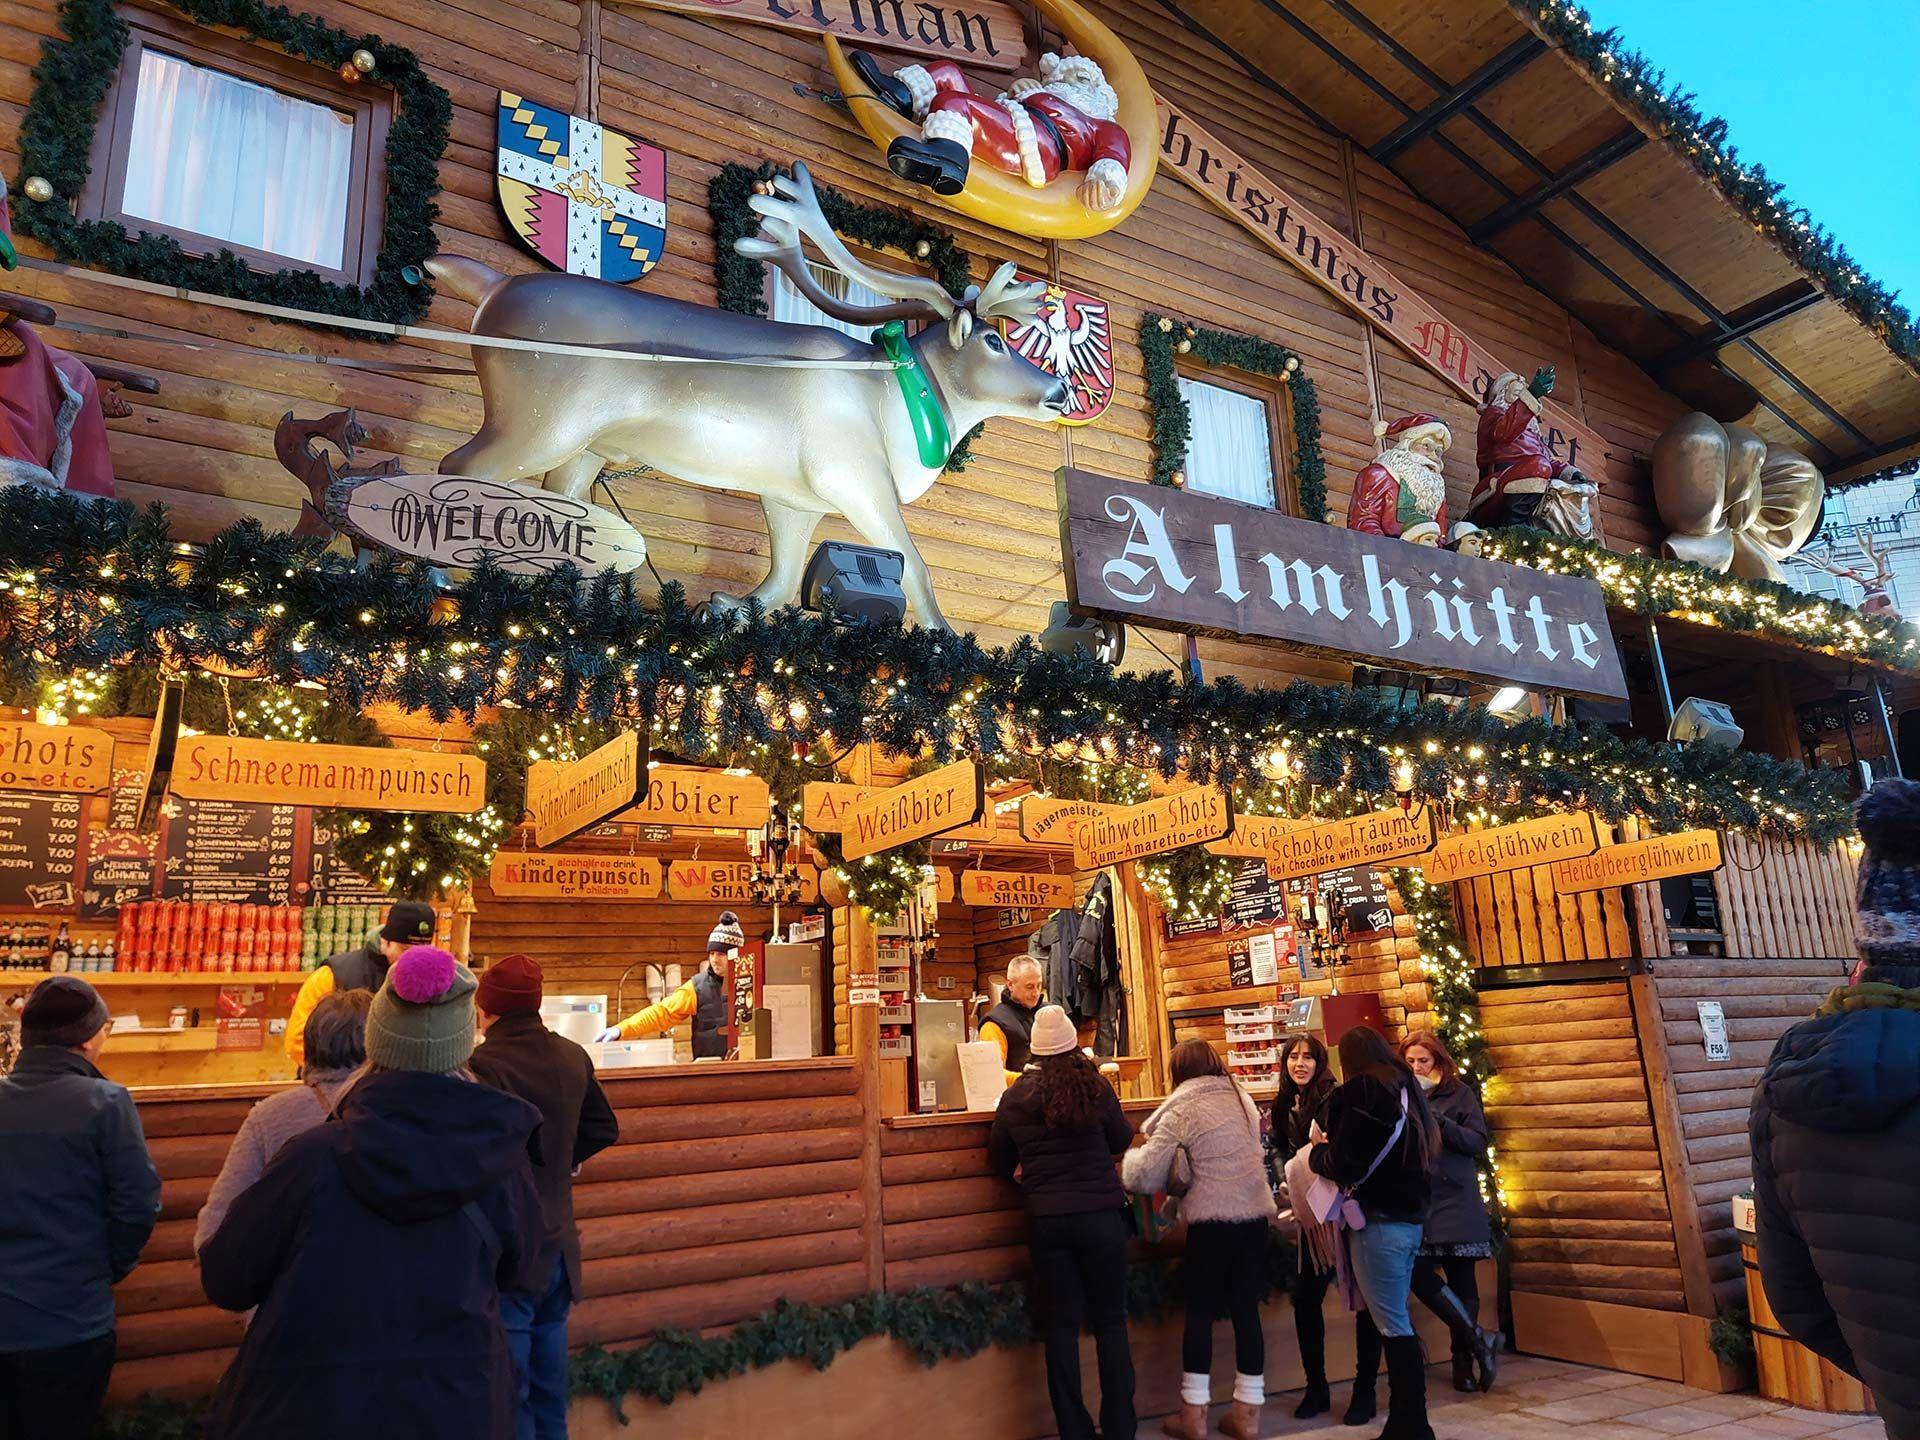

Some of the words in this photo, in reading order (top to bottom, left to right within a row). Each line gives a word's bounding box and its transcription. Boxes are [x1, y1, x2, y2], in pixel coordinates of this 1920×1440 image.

[1156, 106, 1400, 324] hristmas
[1410, 320, 1582, 467] Maet
[392, 494, 597, 563] WELCOME
[1102, 494, 1602, 670] Almhütte
[188, 745, 472, 800] Schneemannpunsch
[539, 741, 631, 831] Schneemannpunsch
[634, 779, 740, 816] ßbier
[856, 787, 955, 844] Weißbier
[48, 832, 76, 844] 7.00
[51, 817, 78, 829] 7.00
[1078, 810, 1157, 856] Glühwein
[1169, 795, 1218, 827] Shots
[1272, 830, 1334, 862] Schoko
[1345, 815, 1420, 846] Träume
[48, 847, 75, 859] 7.00
[528, 857, 545, 866] hot
[613, 860, 636, 868] drink
[1269, 862, 1285, 876] Hot
[1289, 853, 1335, 873] Chocolate
[1337, 846, 1360, 862] with
[1364, 841, 1394, 858] Snaps
[1397, 833, 1428, 850] Shots
[1431, 823, 1585, 874] Apfelglühwein
[1560, 838, 1712, 885] Heidelbeerglühwein
[46, 862, 73, 875] 7.00
[93, 868, 150, 881] GLÜHWEIN
[505, 863, 650, 889] Kinderpunsch
[975, 873, 1063, 897] Radler
[114, 888, 139, 903] 6.50
[561, 885, 576, 894] for
[586, 886, 629, 895] childrens
[993, 892, 1048, 905] SHANDY
